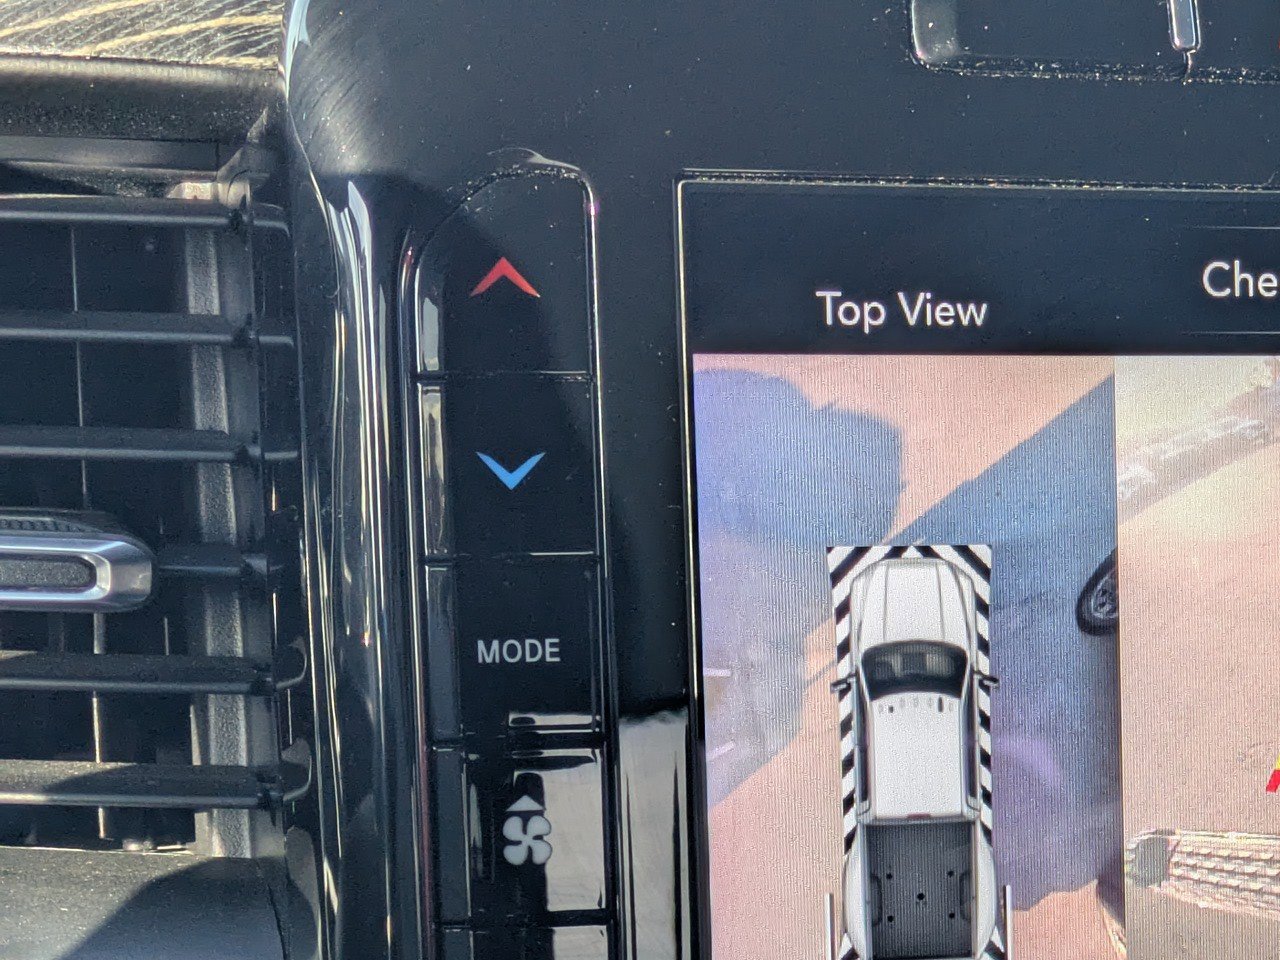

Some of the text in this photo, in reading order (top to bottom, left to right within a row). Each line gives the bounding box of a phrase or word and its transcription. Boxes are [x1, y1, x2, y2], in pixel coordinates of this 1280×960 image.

[816, 291, 989, 332] Top View
[477, 639, 561, 664] MODE
